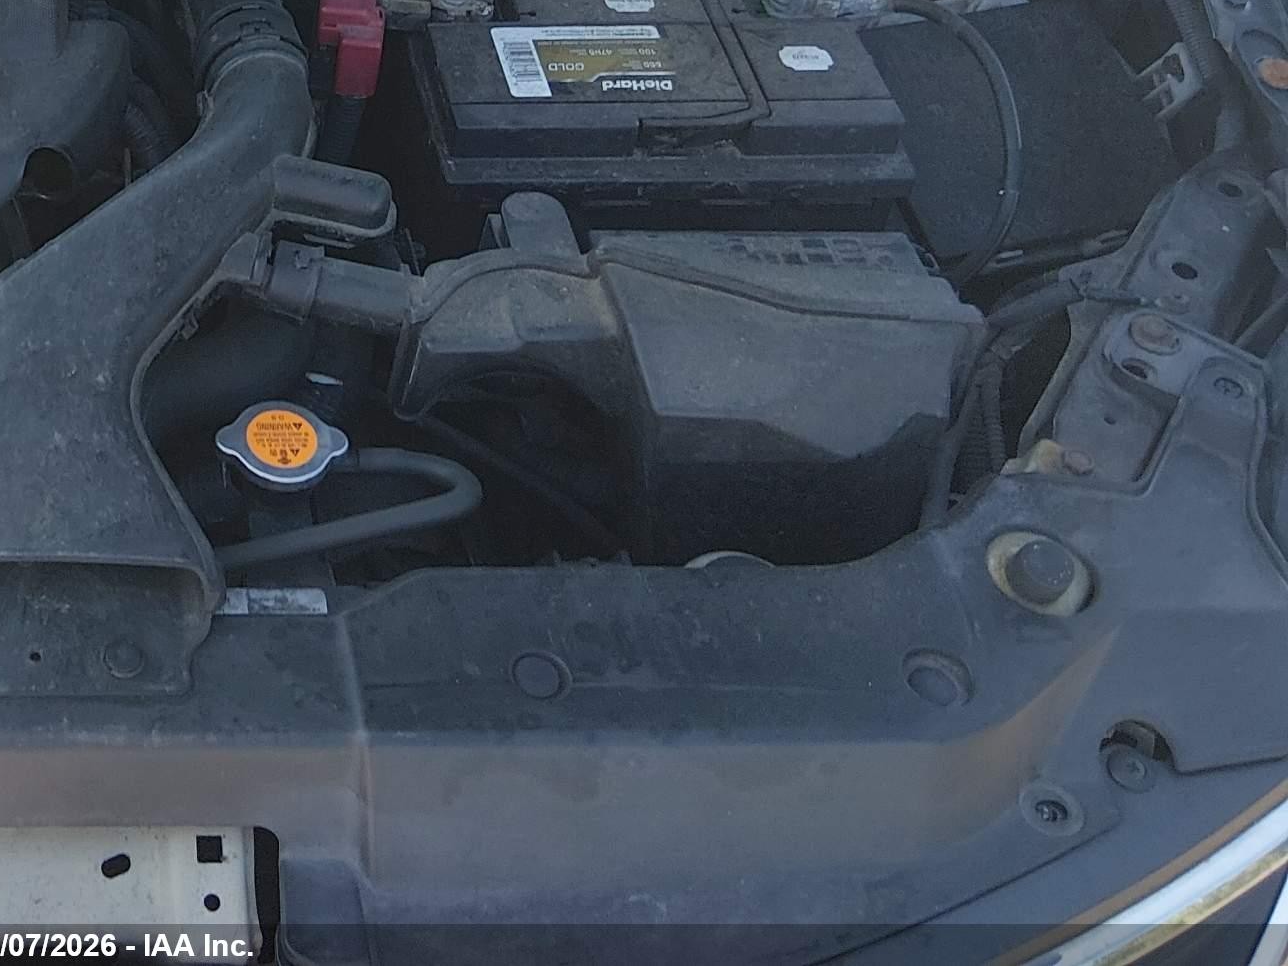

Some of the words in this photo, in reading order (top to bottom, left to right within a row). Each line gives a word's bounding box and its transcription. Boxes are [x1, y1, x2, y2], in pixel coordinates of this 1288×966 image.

[547, 62, 585, 72] GOLD
[601, 79, 673, 91] DieHard
[255, 421, 292, 431] WARNING
